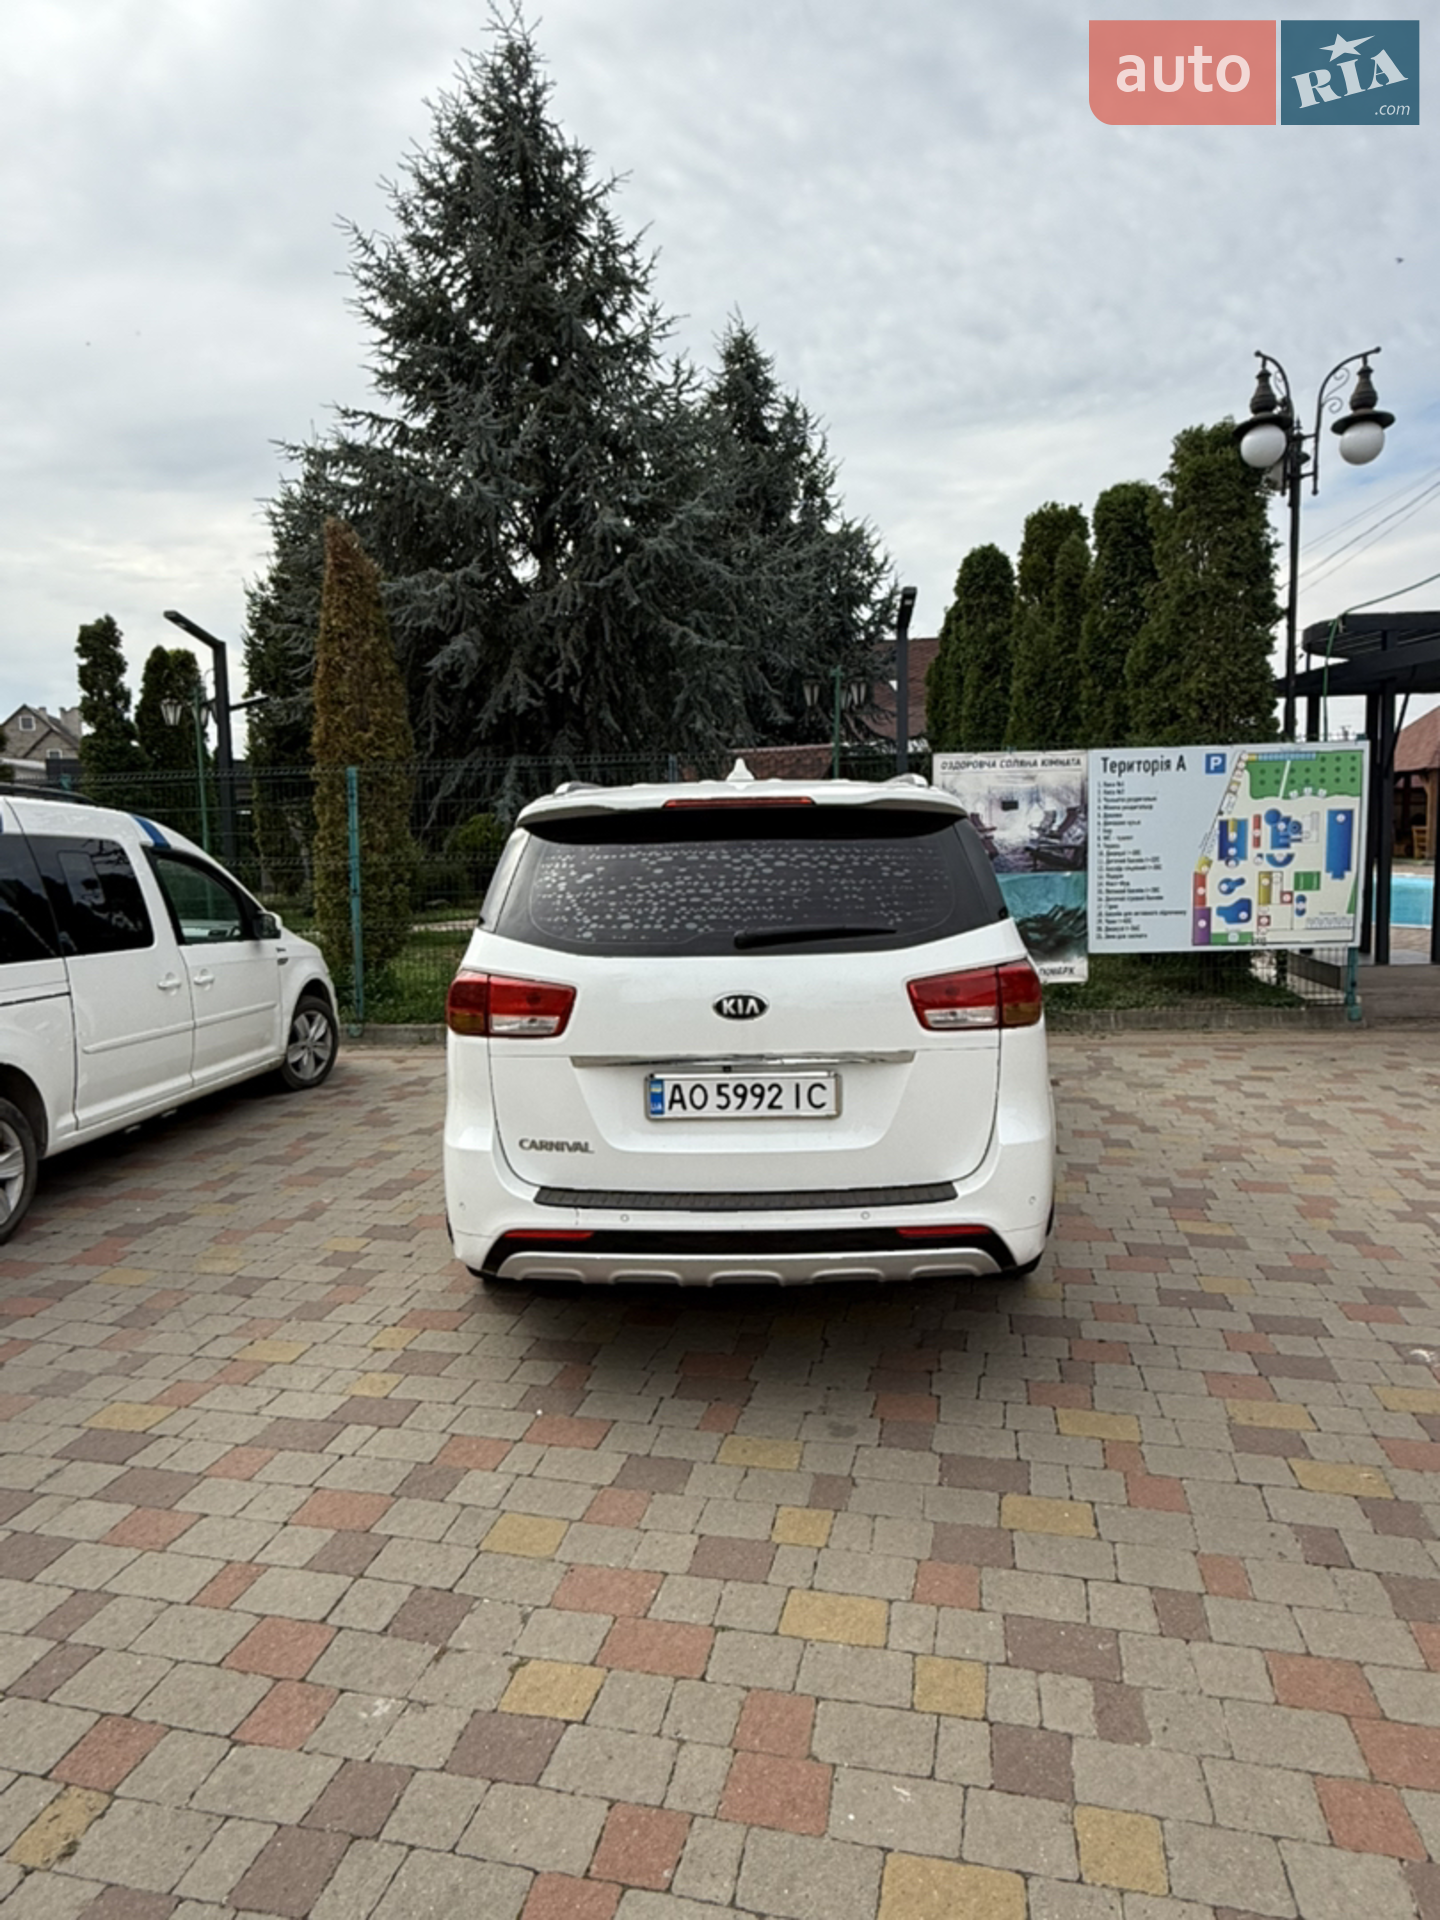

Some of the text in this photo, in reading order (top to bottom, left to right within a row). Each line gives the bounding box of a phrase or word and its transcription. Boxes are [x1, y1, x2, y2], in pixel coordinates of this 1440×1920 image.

[940, 757, 1082, 771] ОЗДОРОВЧА СОЛЯНА КІМНАТА
[1101, 755, 1172, 778] Територія
[1210, 756, 1223, 772] P
[722, 998, 760, 1015] KIA
[668, 1081, 827, 1111] AO 5992 IC
[518, 1138, 595, 1154] CARNIVAL
